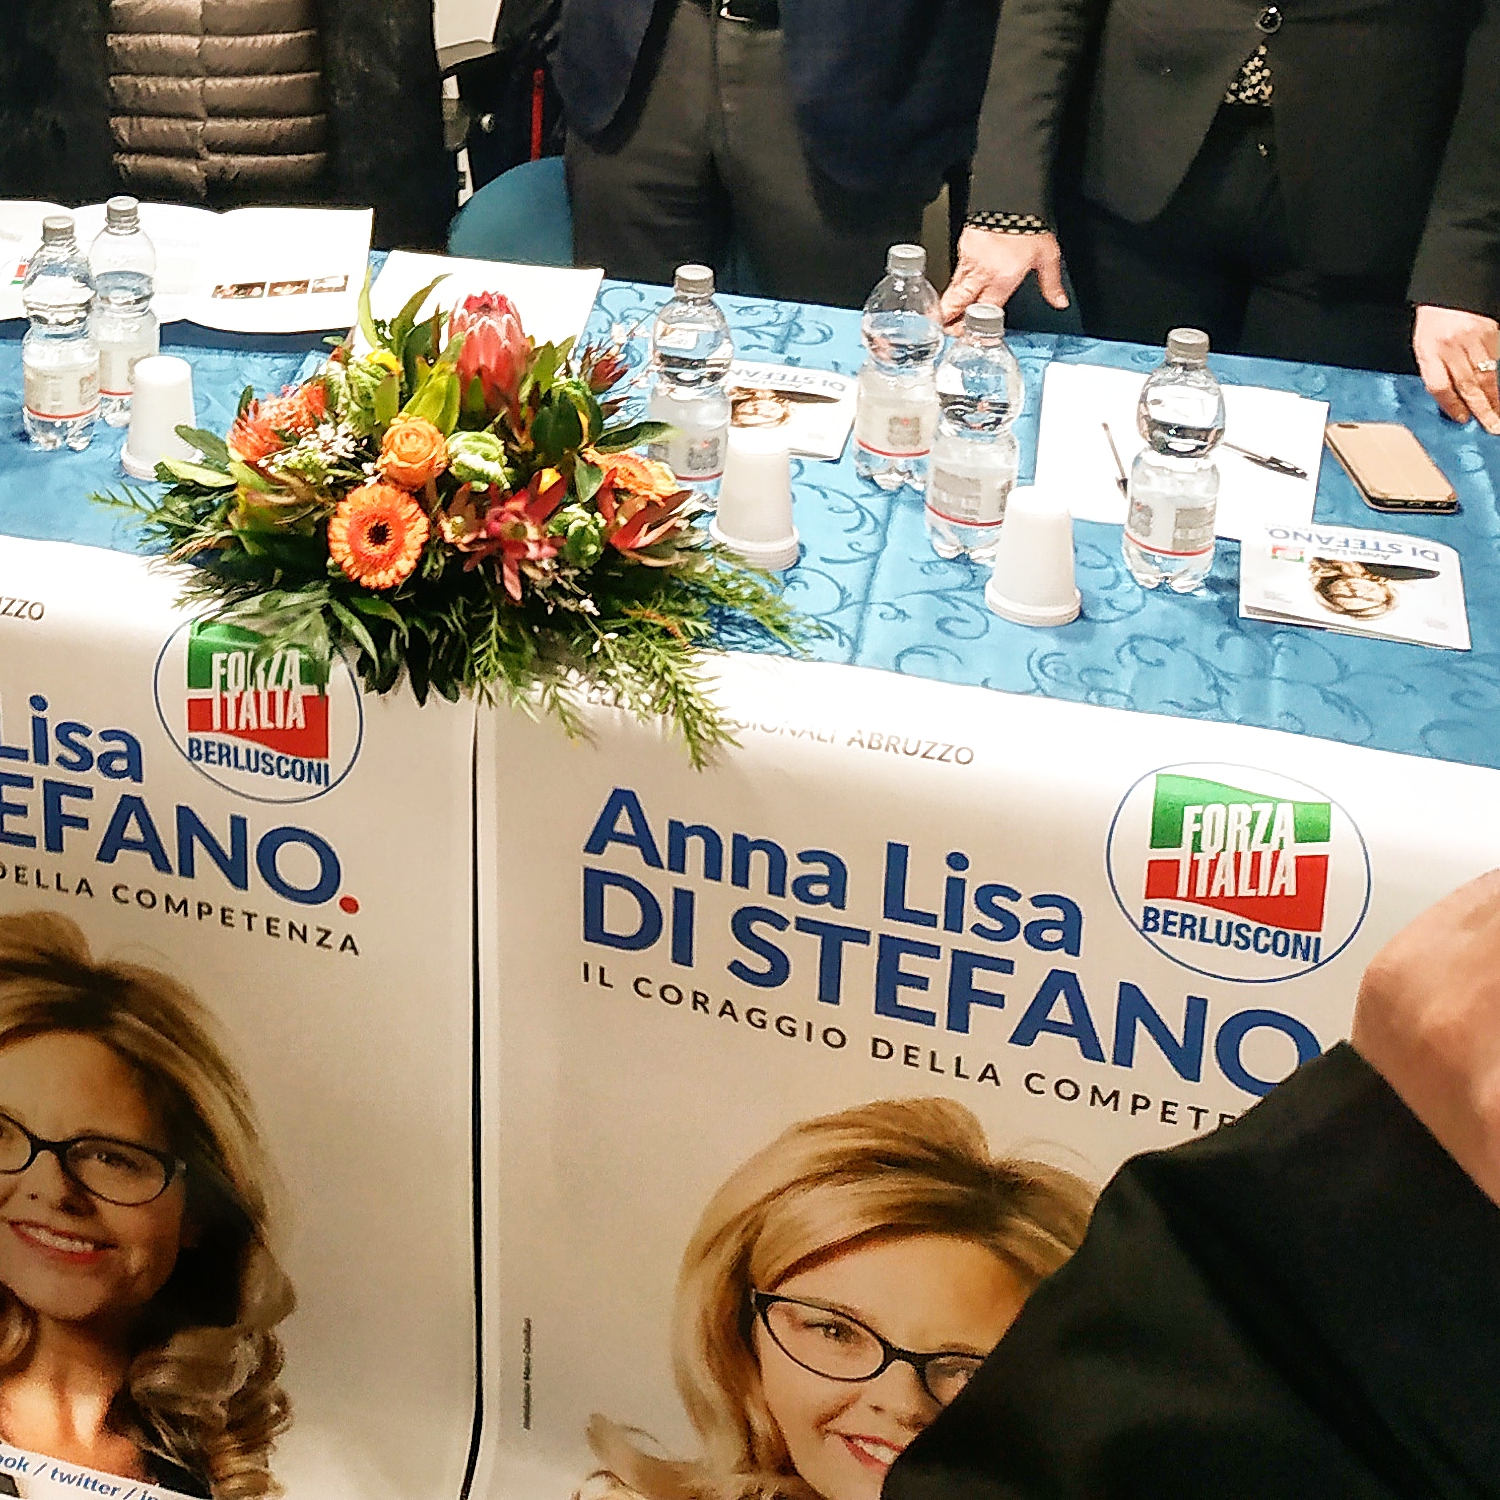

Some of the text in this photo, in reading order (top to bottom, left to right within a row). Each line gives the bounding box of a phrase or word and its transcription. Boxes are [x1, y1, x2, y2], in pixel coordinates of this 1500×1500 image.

[211, 688, 307, 731] ITALIA
[187, 737, 330, 787] BERLUSCONI
[846, 729, 976, 766] ABRUZZO
[1181, 802, 1296, 853] FORZA
[582, 787, 1083, 958] Anna Lisa
[1176, 850, 1297, 899] ITALIA
[112, 883, 361, 956] COMPETENZA
[583, 866, 695, 968] DI
[1142, 905, 1322, 964] BERLUSCONI
[582, 962, 614, 989] IL
[632, 976, 848, 1050] CORAGGIO
[871, 1037, 1001, 1088] DELLA
[51, 1466, 121, 1497] twitter
